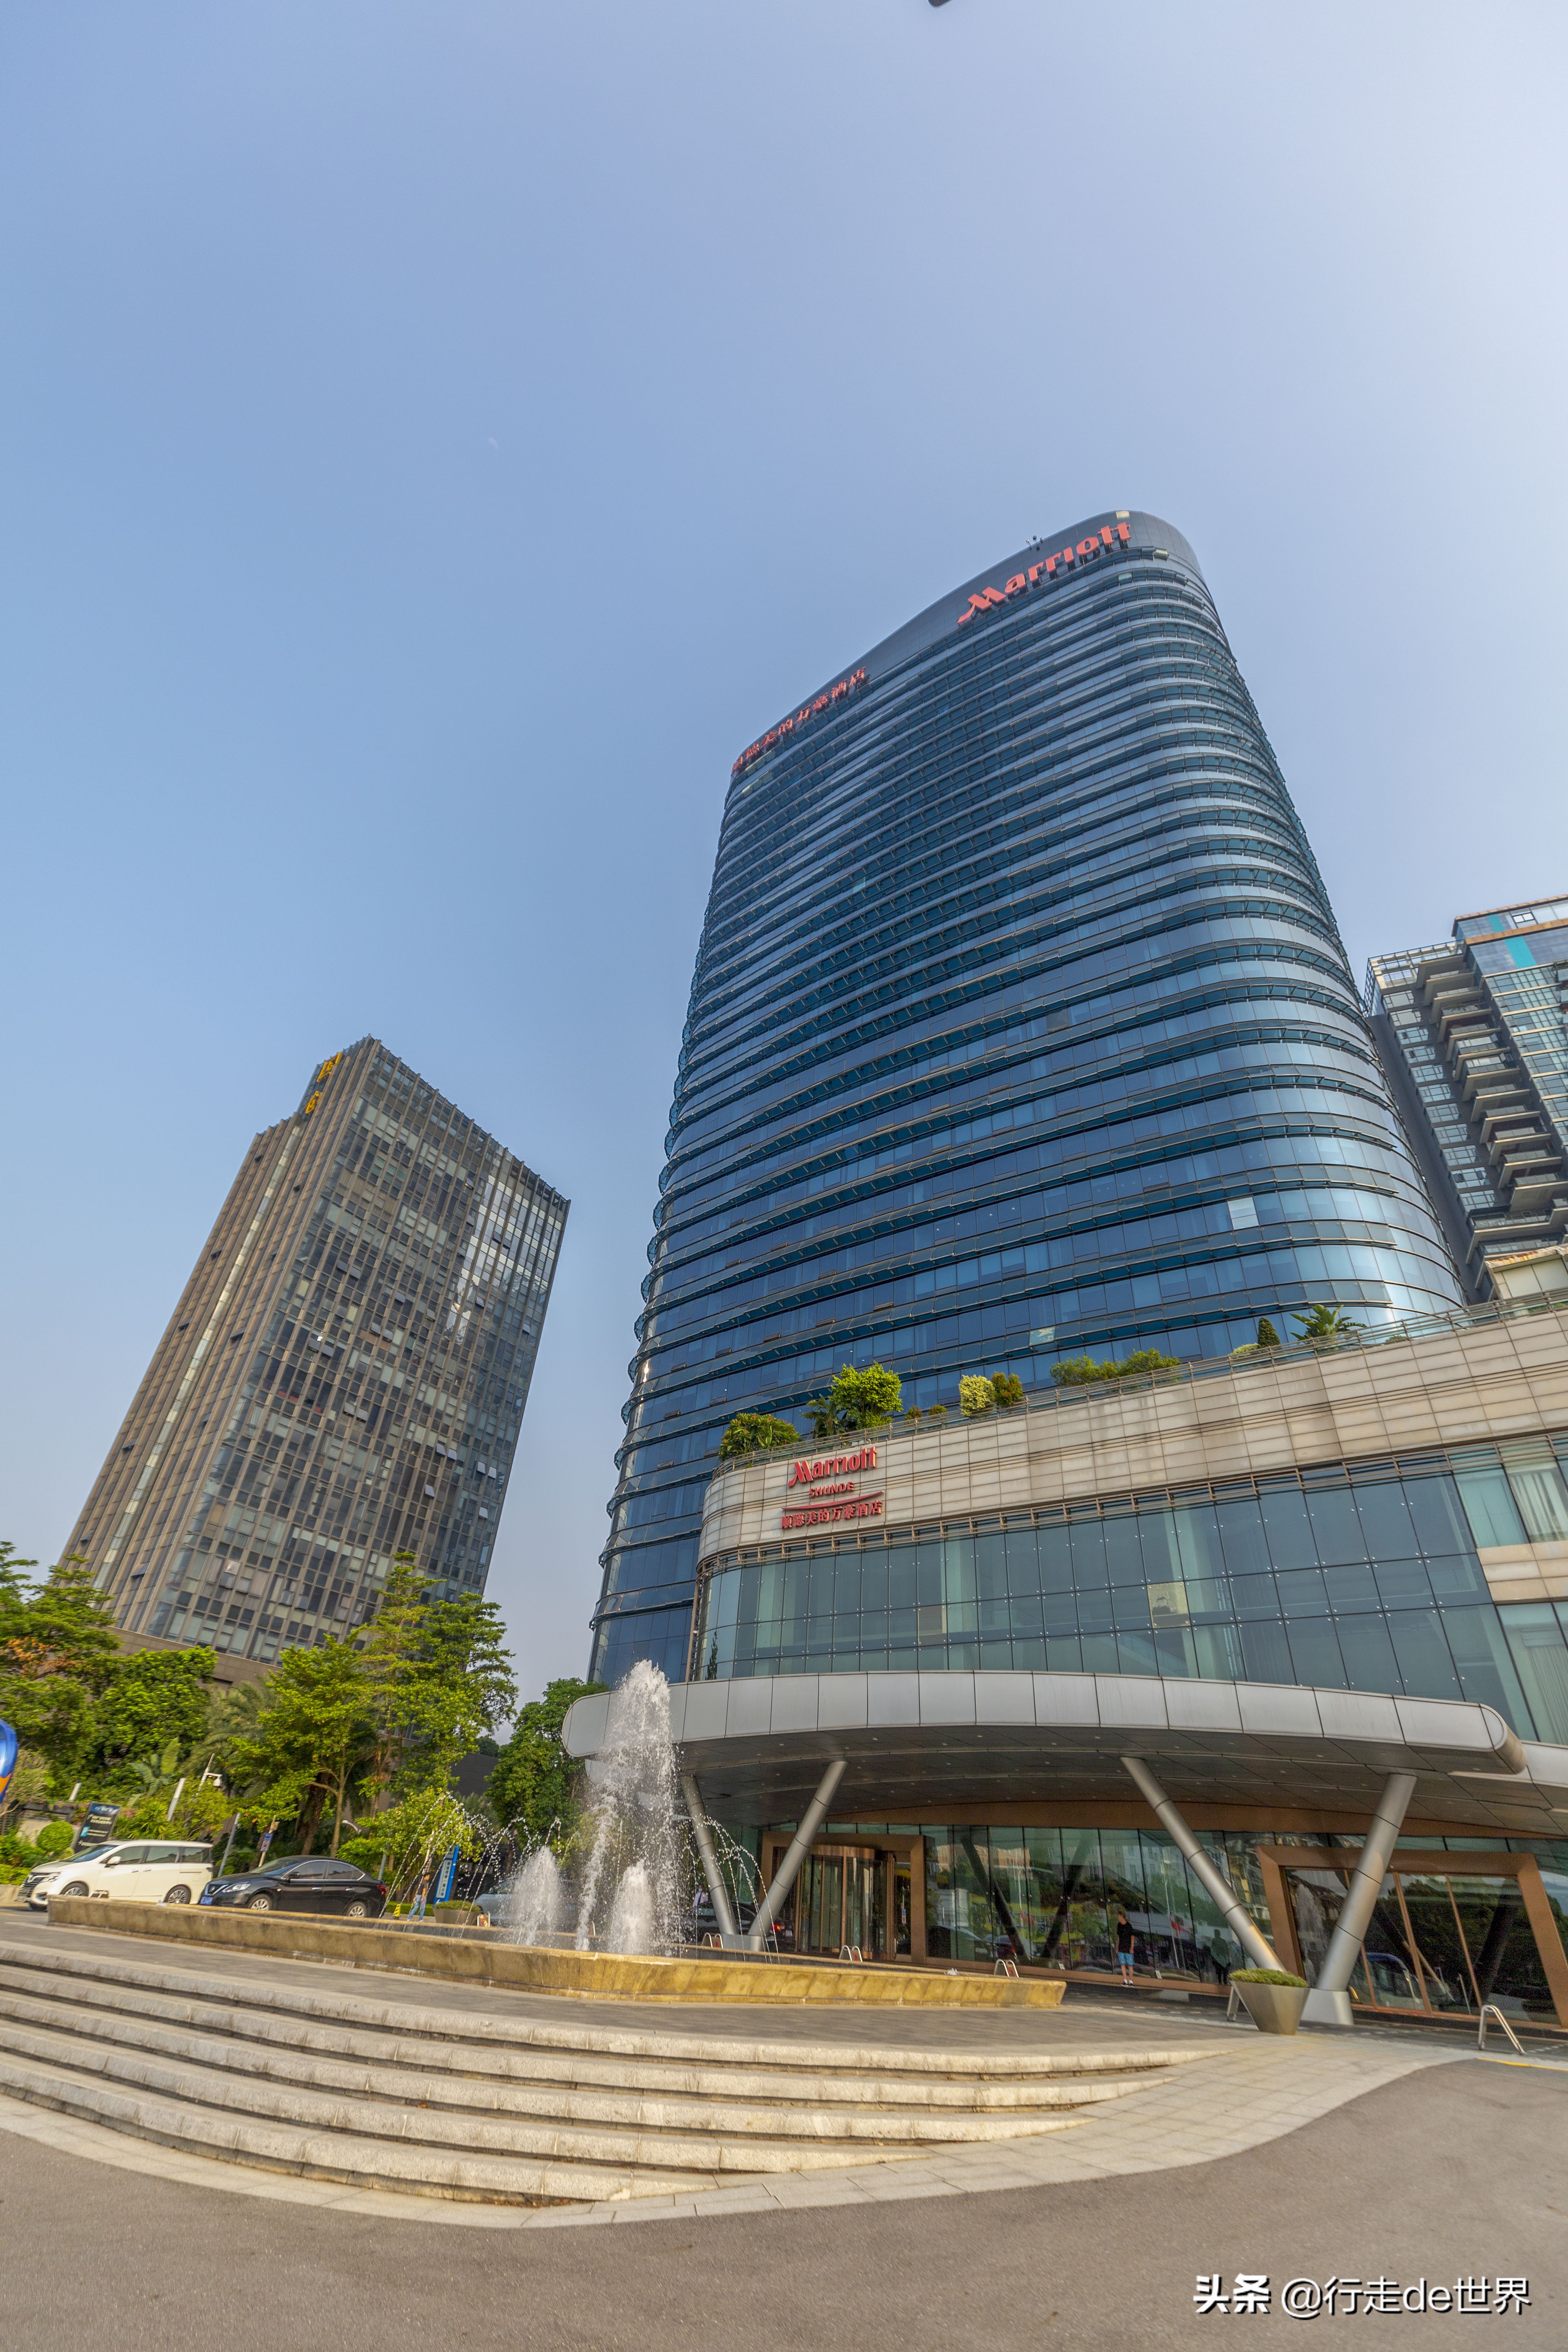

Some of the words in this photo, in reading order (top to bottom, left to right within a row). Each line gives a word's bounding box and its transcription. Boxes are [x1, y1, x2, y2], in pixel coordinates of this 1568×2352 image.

[958, 522, 1131, 624] Marriott
[787, 1446, 877, 1487] Marriott
[809, 1481, 854, 1498] SHUNDE
[781, 1500, 883, 1529] 顺德美的万豪酒店
